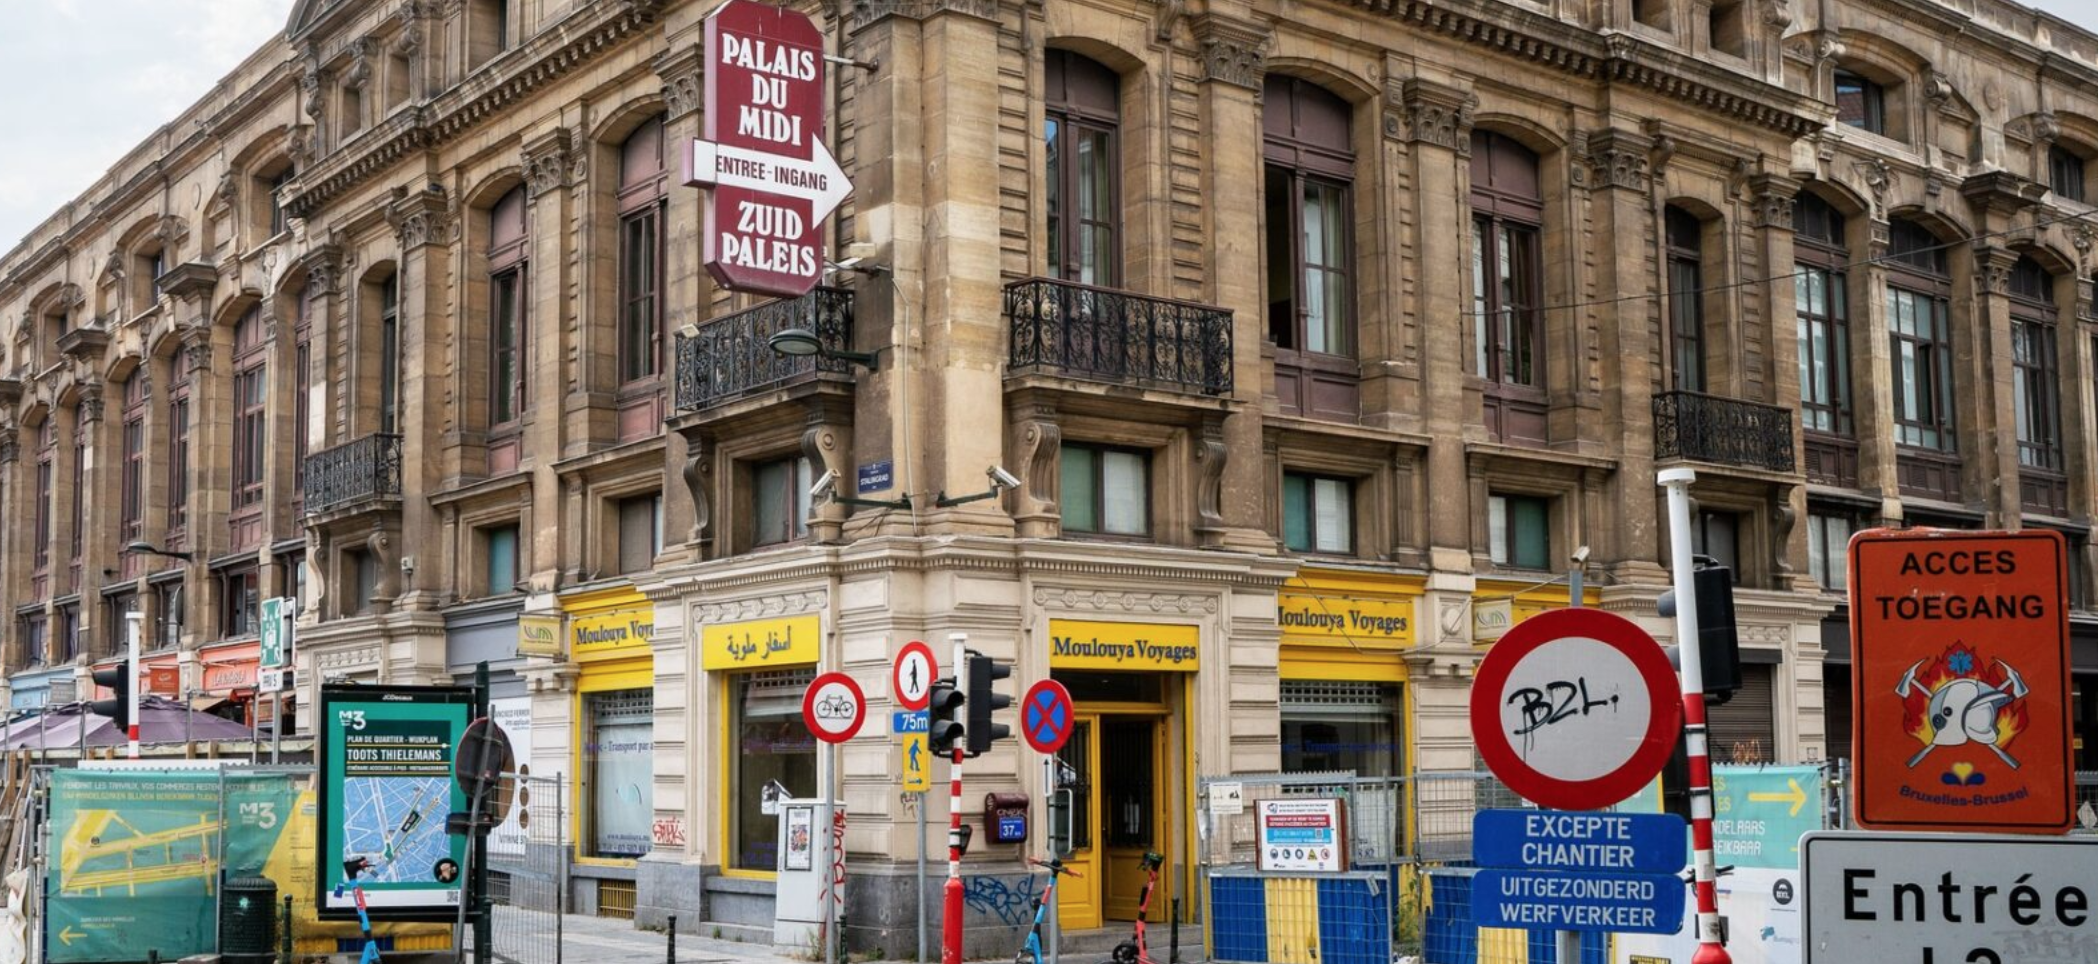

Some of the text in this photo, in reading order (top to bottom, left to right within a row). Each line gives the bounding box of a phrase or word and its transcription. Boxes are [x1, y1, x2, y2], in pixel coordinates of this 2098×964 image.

[722, 33, 816, 82] PALAIS
[752, 73, 788, 109] DU
[738, 106, 802, 147] MIDI
[738, 200, 803, 240] ZUID
[721, 232, 816, 278] PALEIS
[1900, 550, 2016, 576] ACCES
[1875, 595, 2045, 620] TOEGANG
[576, 624, 628, 646] Moulouya
[630, 619, 654, 641] Voya
[1348, 609, 1407, 635] Voyages
[727, 625, 791, 661] أسفار ملوية
[1052, 636, 1196, 663] Moulouya Voyages
[902, 713, 928, 730] 75m
[346, 735, 364, 743] PLAN
[364, 735, 372, 743] DE
[373, 735, 404, 743] QUARTIER
[608, 741, 637, 753] Transport
[346, 749, 442, 760] TOOTS THIELEMANS
[196, 783, 220, 791] RESTEN
[1899, 785, 2030, 806] Bruxelles-Brussel
[1003, 825, 1015, 836] 37
[1526, 814, 1632, 840] EXCEPTE
[1712, 819, 1765, 836] NDELAARS
[1522, 842, 1634, 867] CHANTIER
[1713, 840, 1761, 856] REIKBAAR
[1501, 876, 1655, 900] UITGEZONDERD
[1843, 868, 2089, 927] Entrée
[1500, 902, 1656, 927] WERFVERKEER
